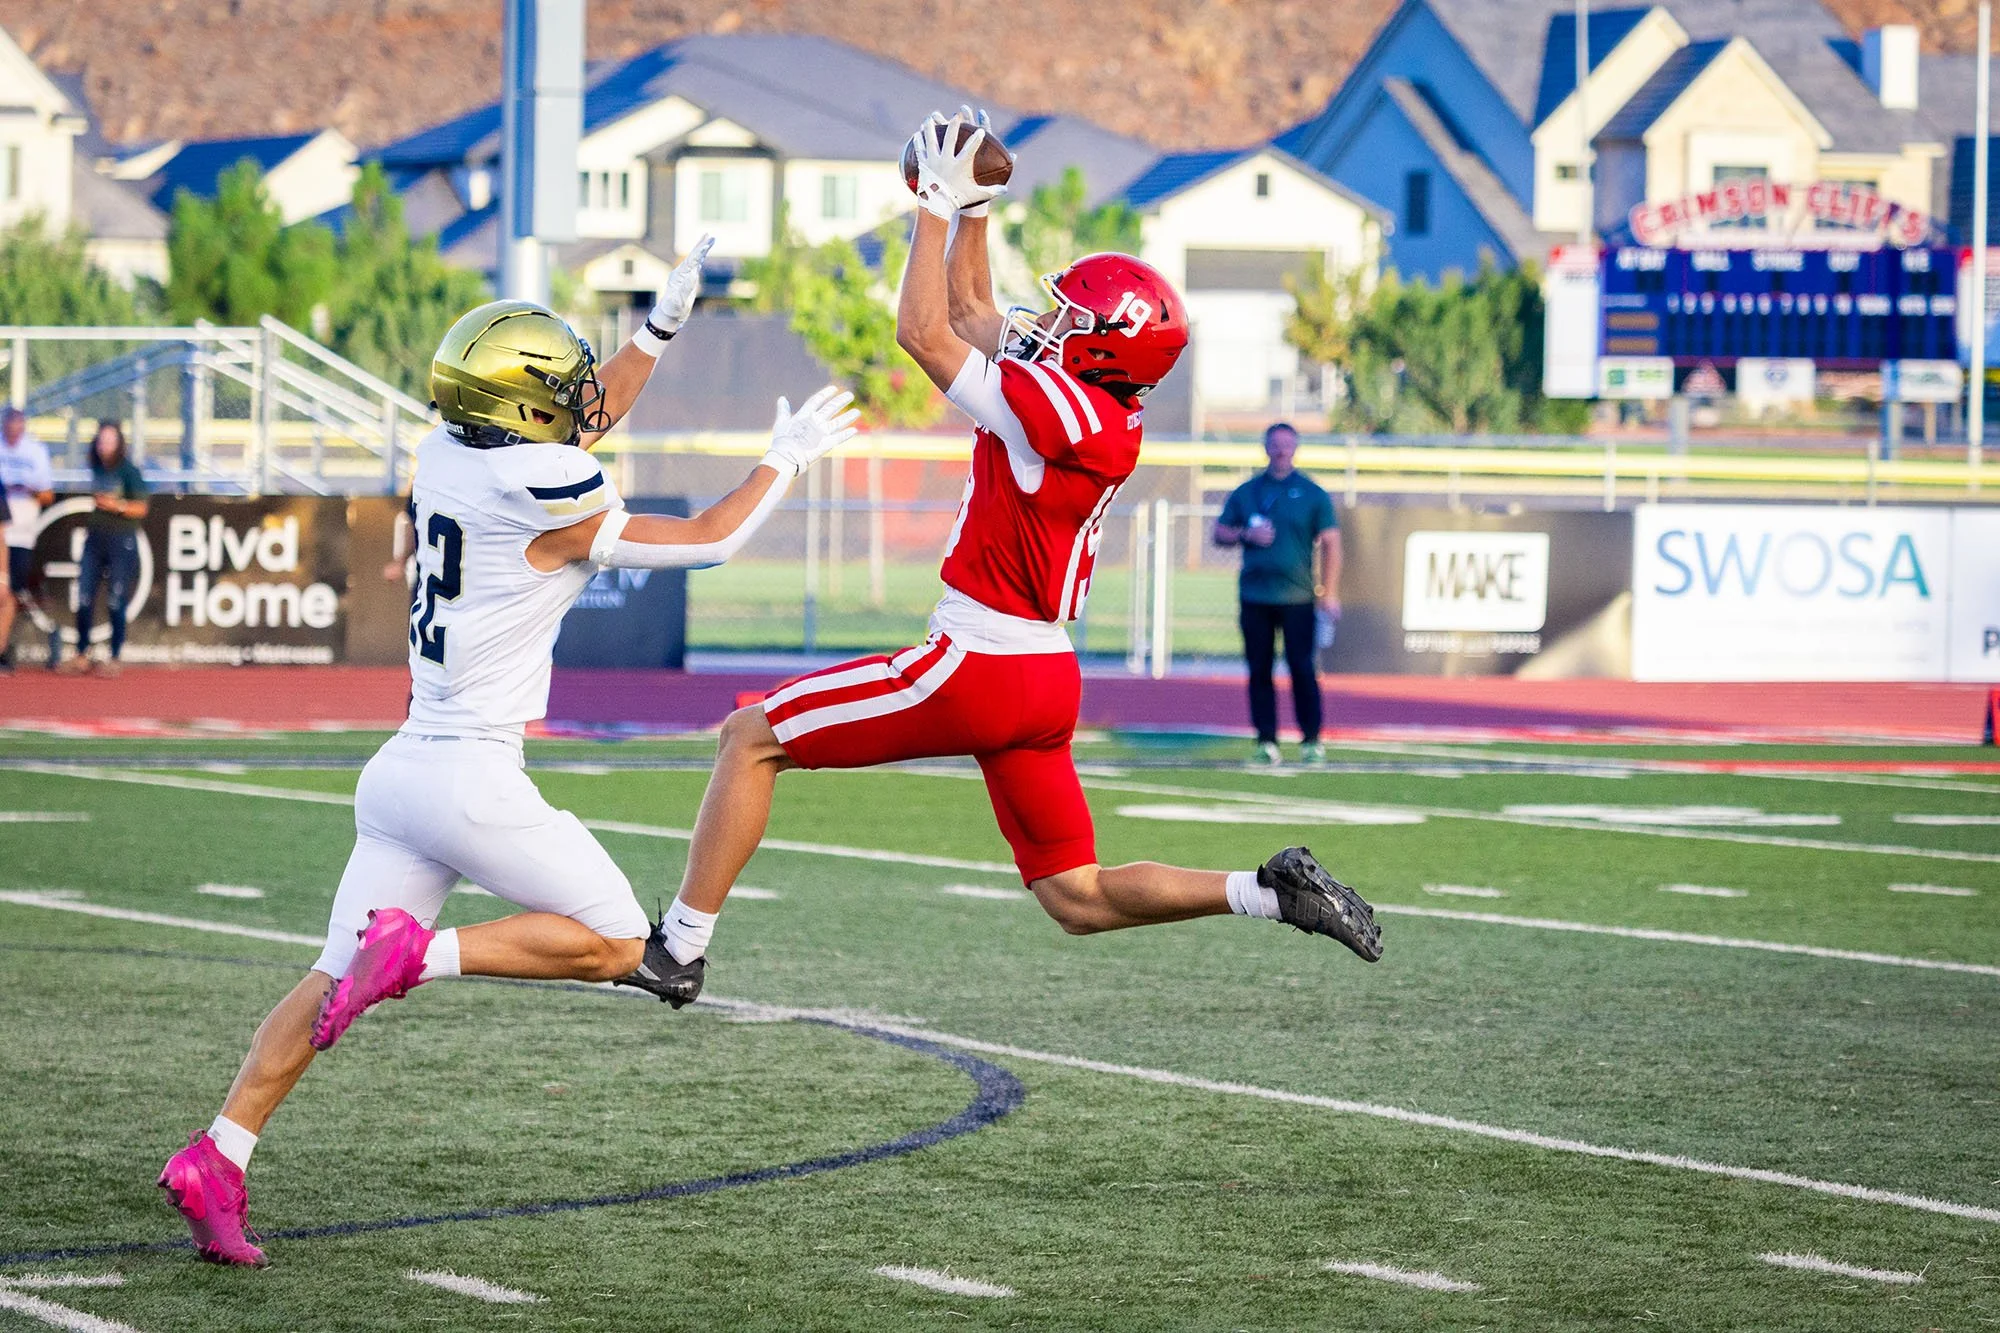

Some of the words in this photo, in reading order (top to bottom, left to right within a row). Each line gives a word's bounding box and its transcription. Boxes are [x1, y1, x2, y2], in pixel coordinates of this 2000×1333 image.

[1630, 181, 1792, 245] CRIMSON
[1108, 291, 1153, 338] 19
[168, 514, 299, 573] Blvd
[1655, 529, 1931, 599] SWOSA
[166, 573, 338, 628] Home
[1426, 552, 1527, 601] MAKE
